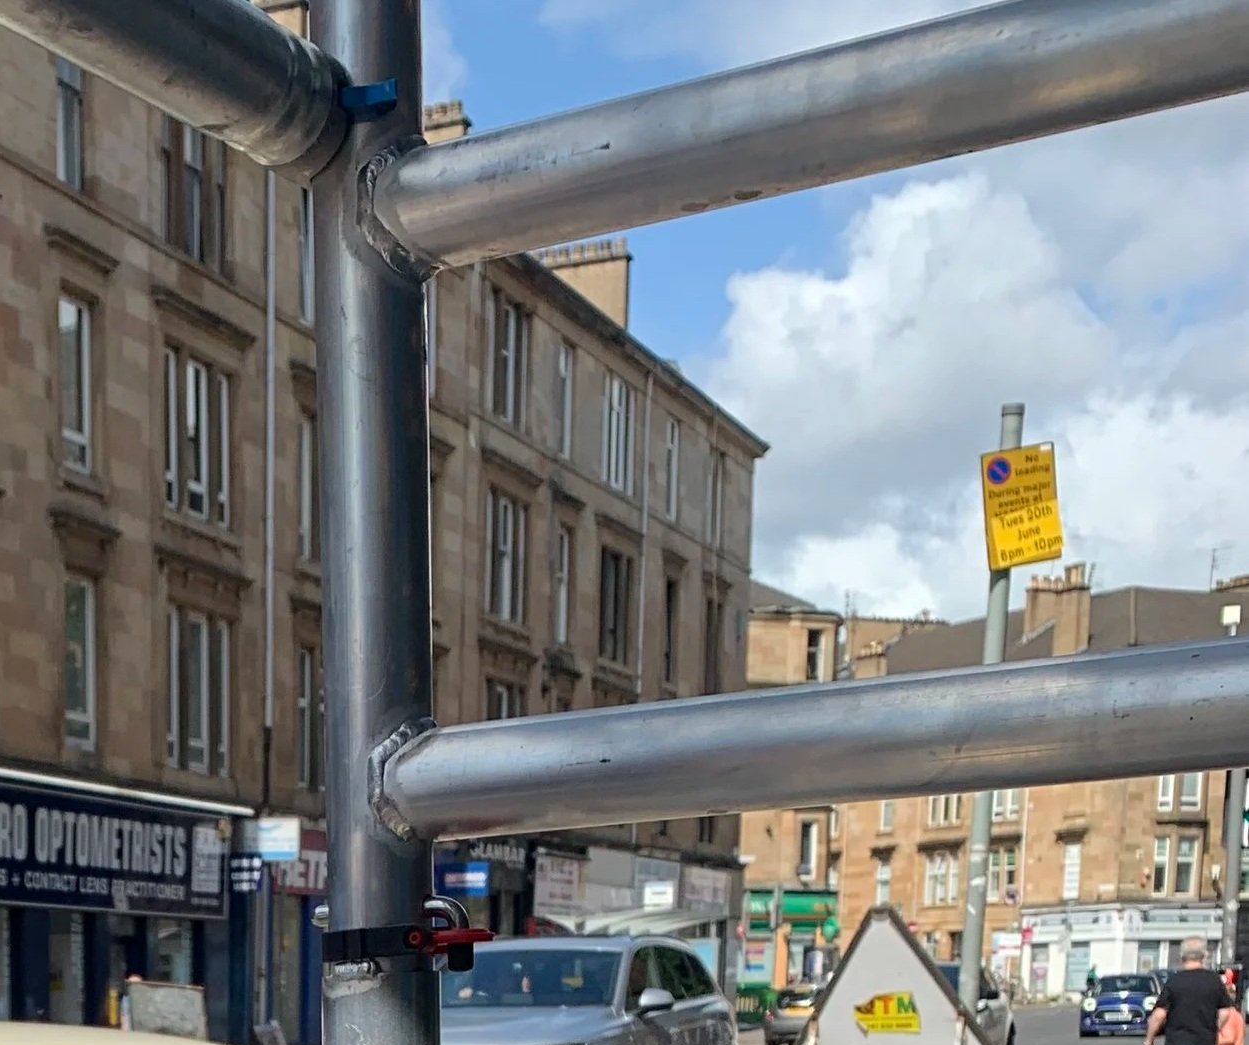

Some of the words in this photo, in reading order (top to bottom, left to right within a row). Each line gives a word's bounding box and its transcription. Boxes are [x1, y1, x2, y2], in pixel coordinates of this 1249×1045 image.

[1025, 454, 1039, 463] No
[988, 486, 1020, 500] During
[1023, 481, 1051, 494] major
[998, 496, 1030, 509] events
[1033, 492, 1043, 503] at
[999, 514, 1024, 529] Tues
[1027, 505, 1053, 522] 20th
[1017, 525, 1041, 542] June
[1034, 535, 1063, 552] 10pm
[34, 806, 188, 877] OPTOMETRISTS
[24, 870, 77, 892] CONTACT
[79, 877, 108, 895] LENS
[111, 879, 186, 901] PRACTITIONER
